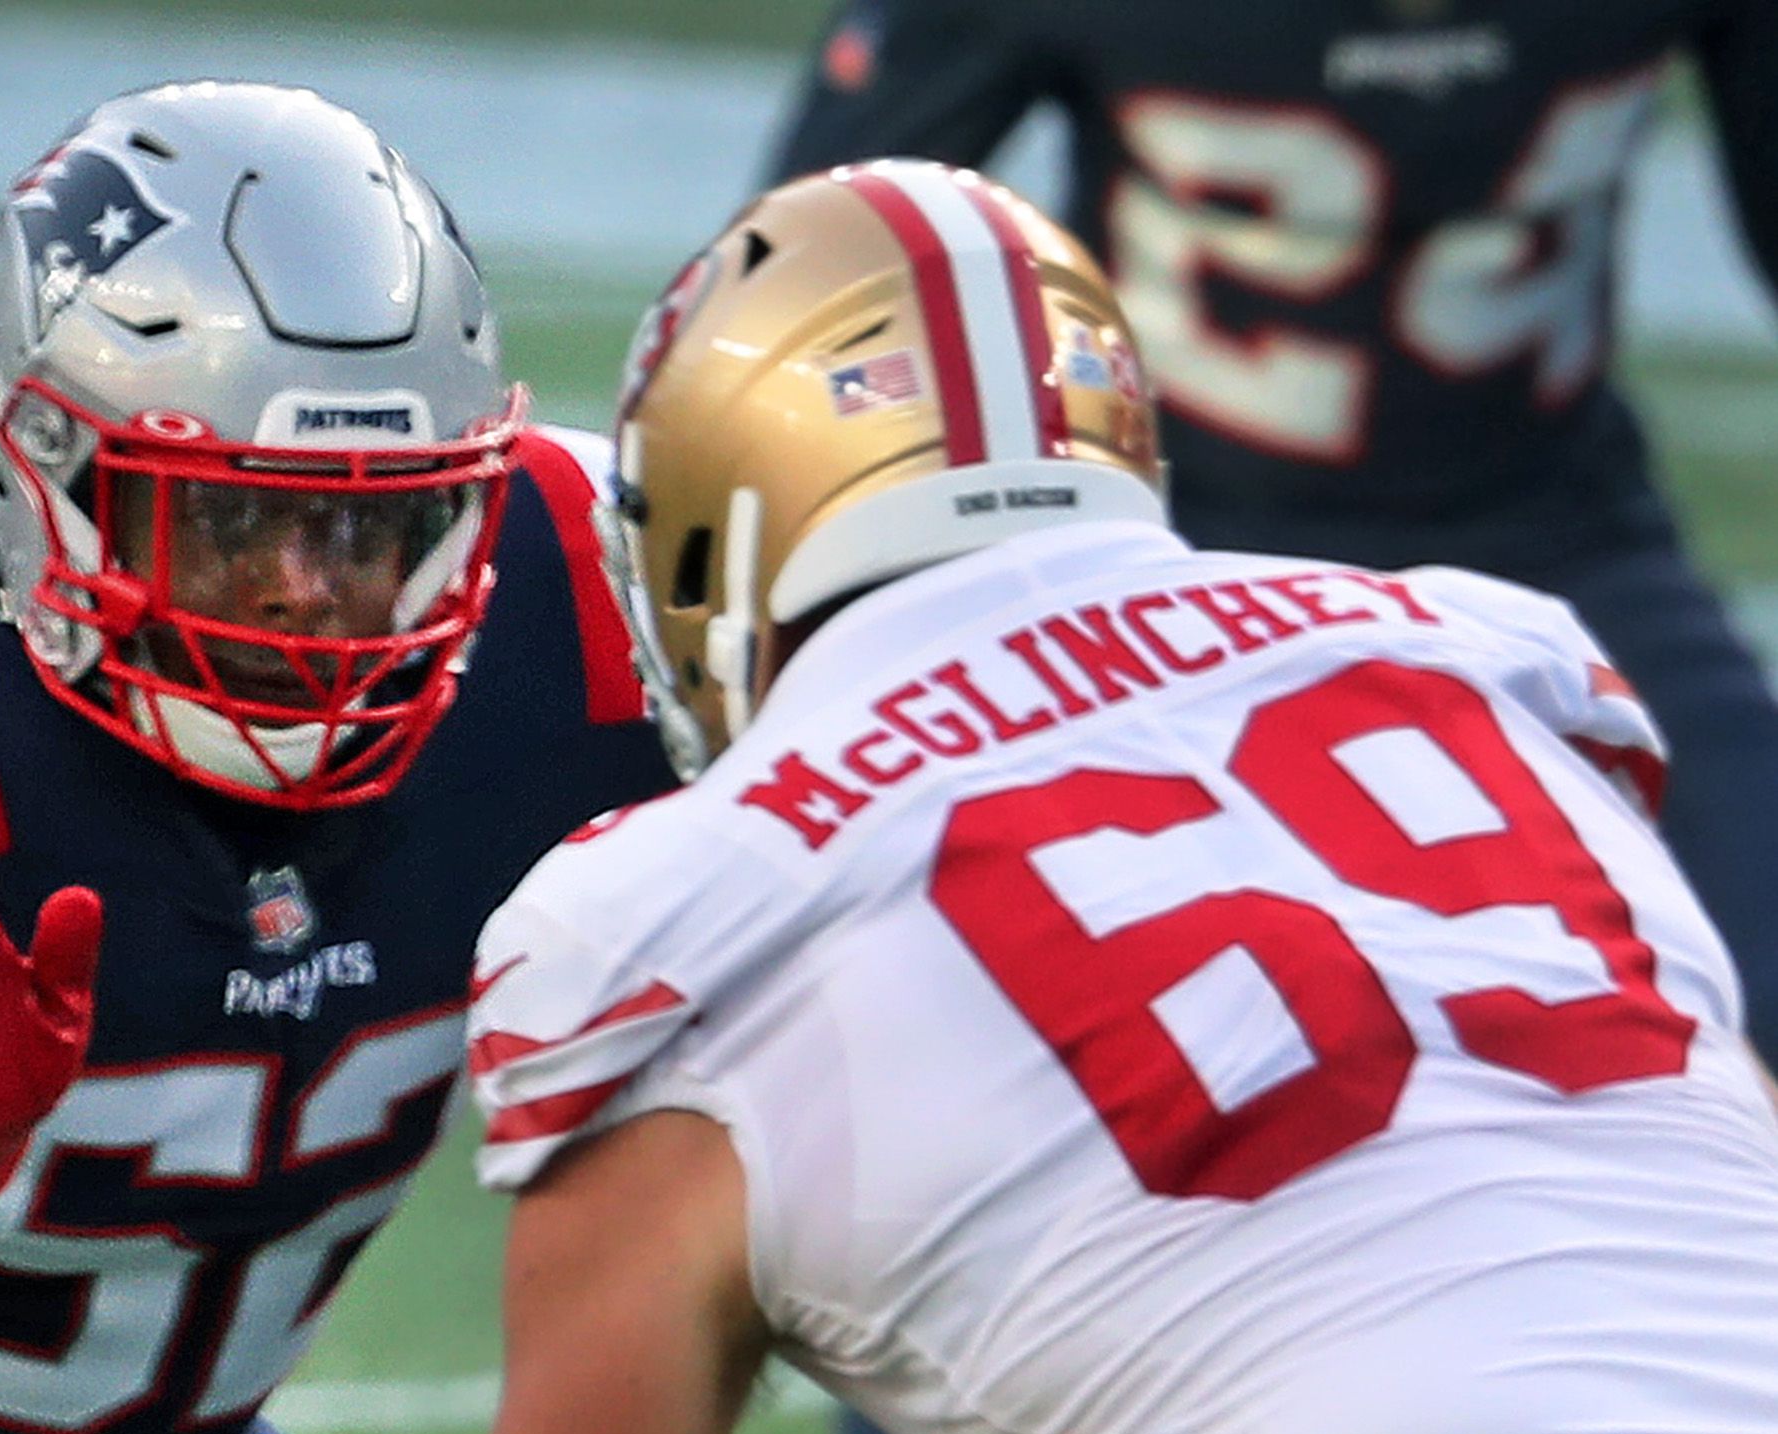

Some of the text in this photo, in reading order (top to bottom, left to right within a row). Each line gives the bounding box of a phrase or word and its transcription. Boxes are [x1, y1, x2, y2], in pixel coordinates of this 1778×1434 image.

[1106, 86, 1674, 464] 24
[738, 567, 1444, 852] McGLINCHEY
[928, 658, 1698, 1202] 69
